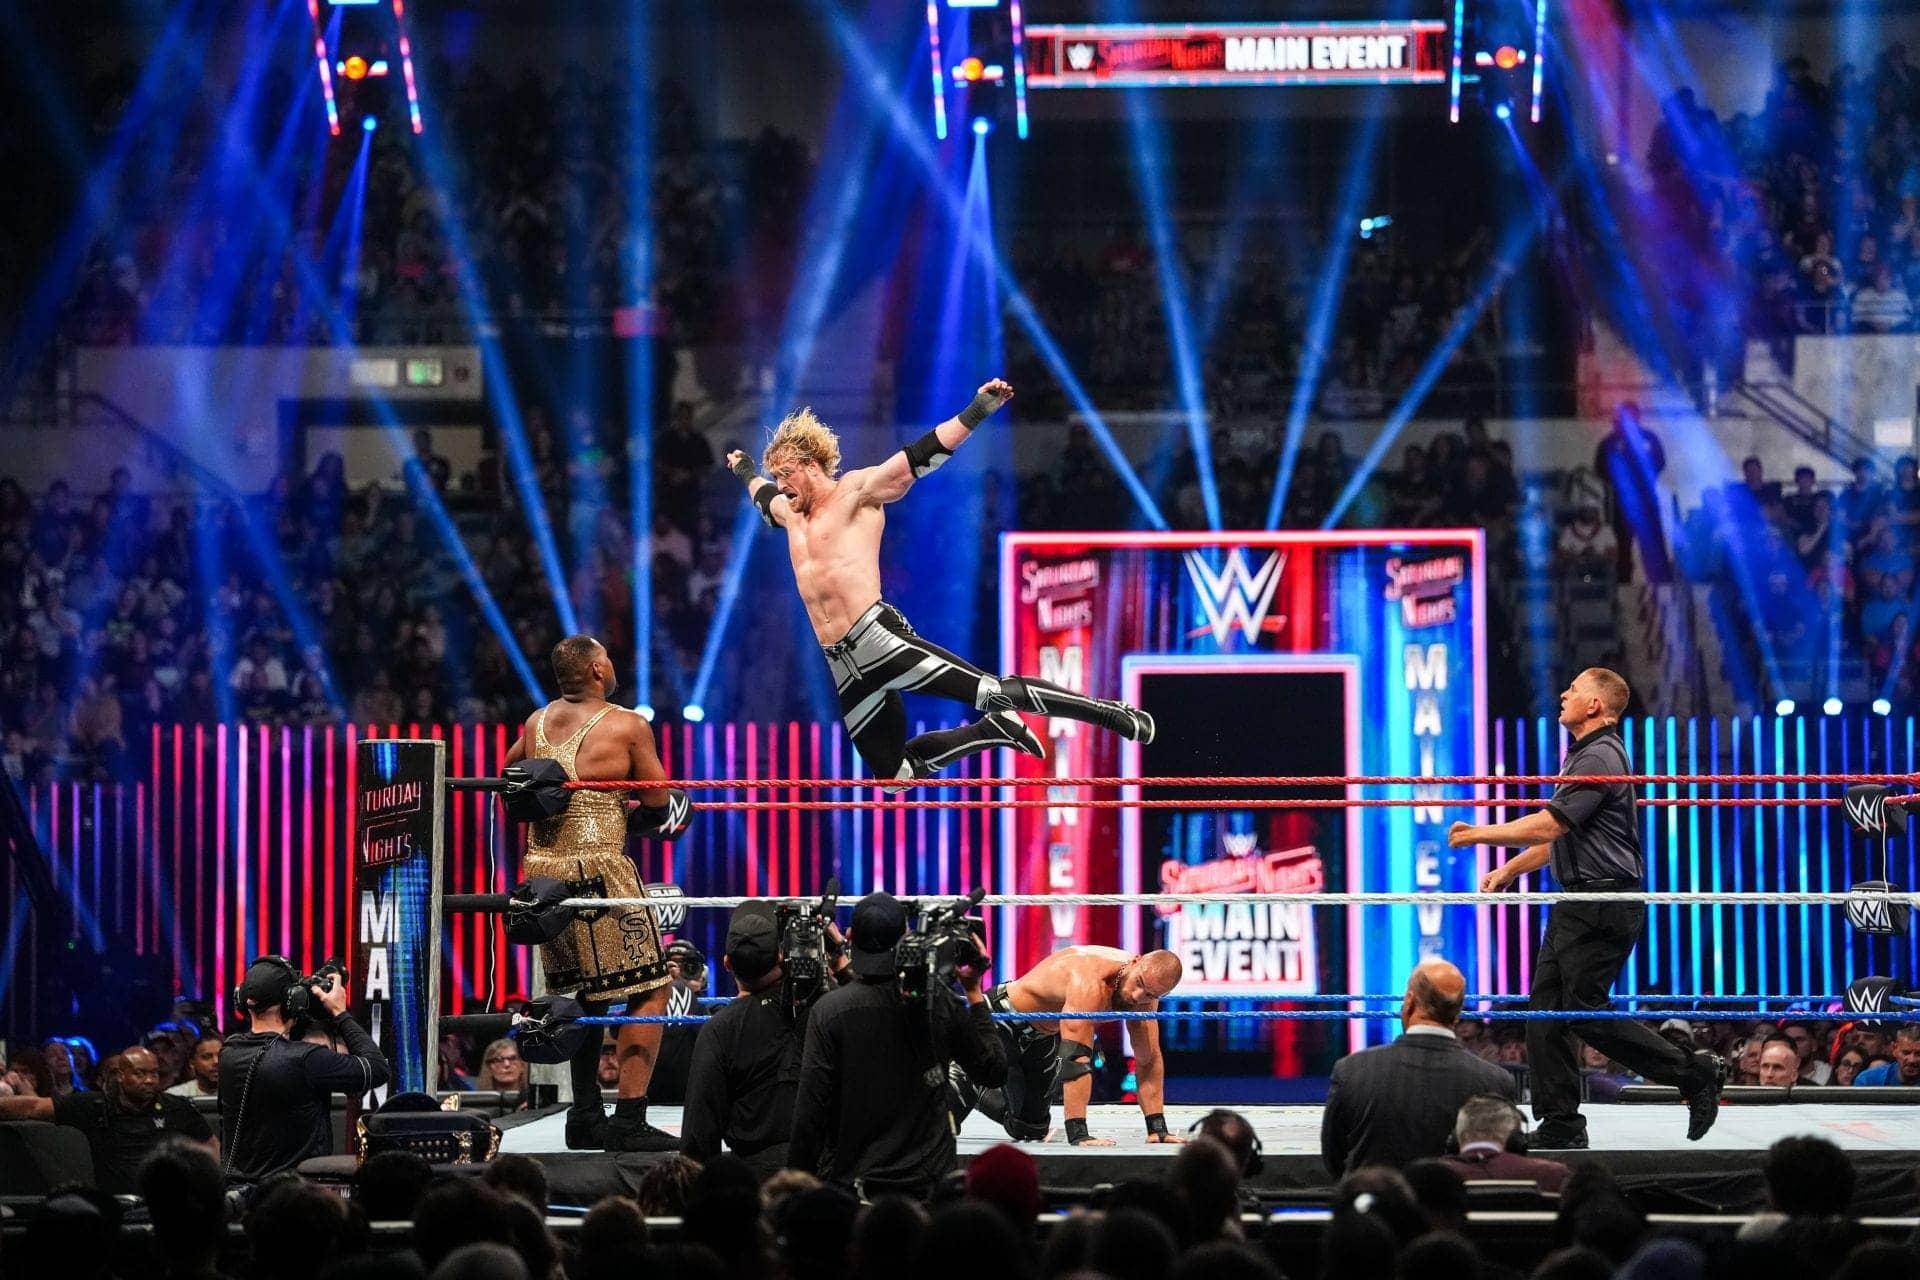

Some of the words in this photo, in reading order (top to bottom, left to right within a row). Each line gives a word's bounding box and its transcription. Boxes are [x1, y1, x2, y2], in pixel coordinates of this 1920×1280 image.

[1225, 36, 1309, 71] MAIN
[1312, 35, 1407, 70] EVENT
[1182, 900, 1300, 941] MAIN
[1183, 940, 1301, 981] EVENT
